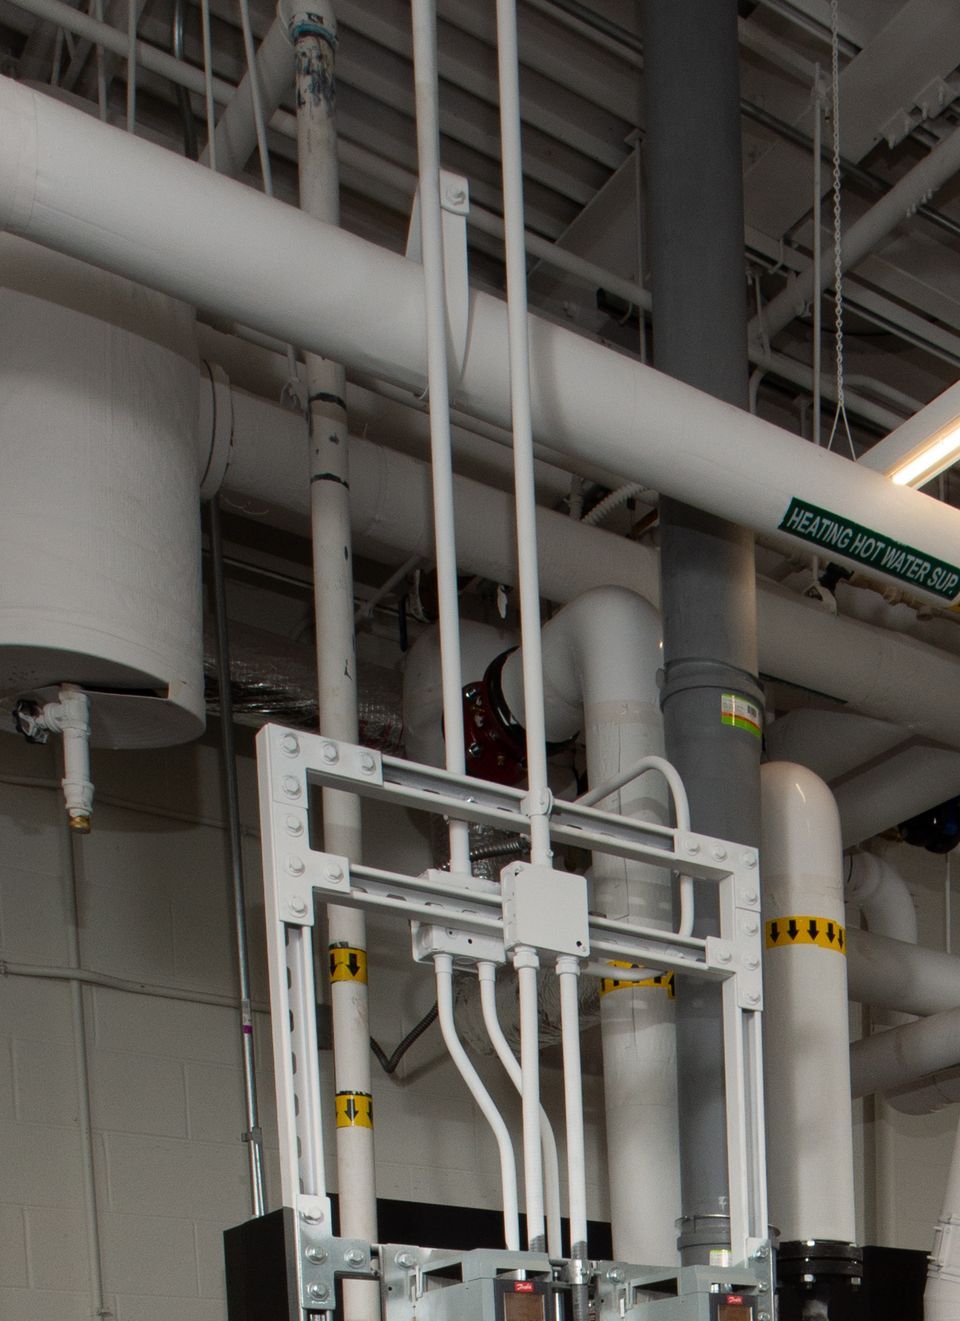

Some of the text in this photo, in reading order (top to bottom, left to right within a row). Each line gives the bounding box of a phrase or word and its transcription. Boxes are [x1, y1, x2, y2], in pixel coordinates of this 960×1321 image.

[786, 507, 960, 595] HEATING HOT WATER SUP.
